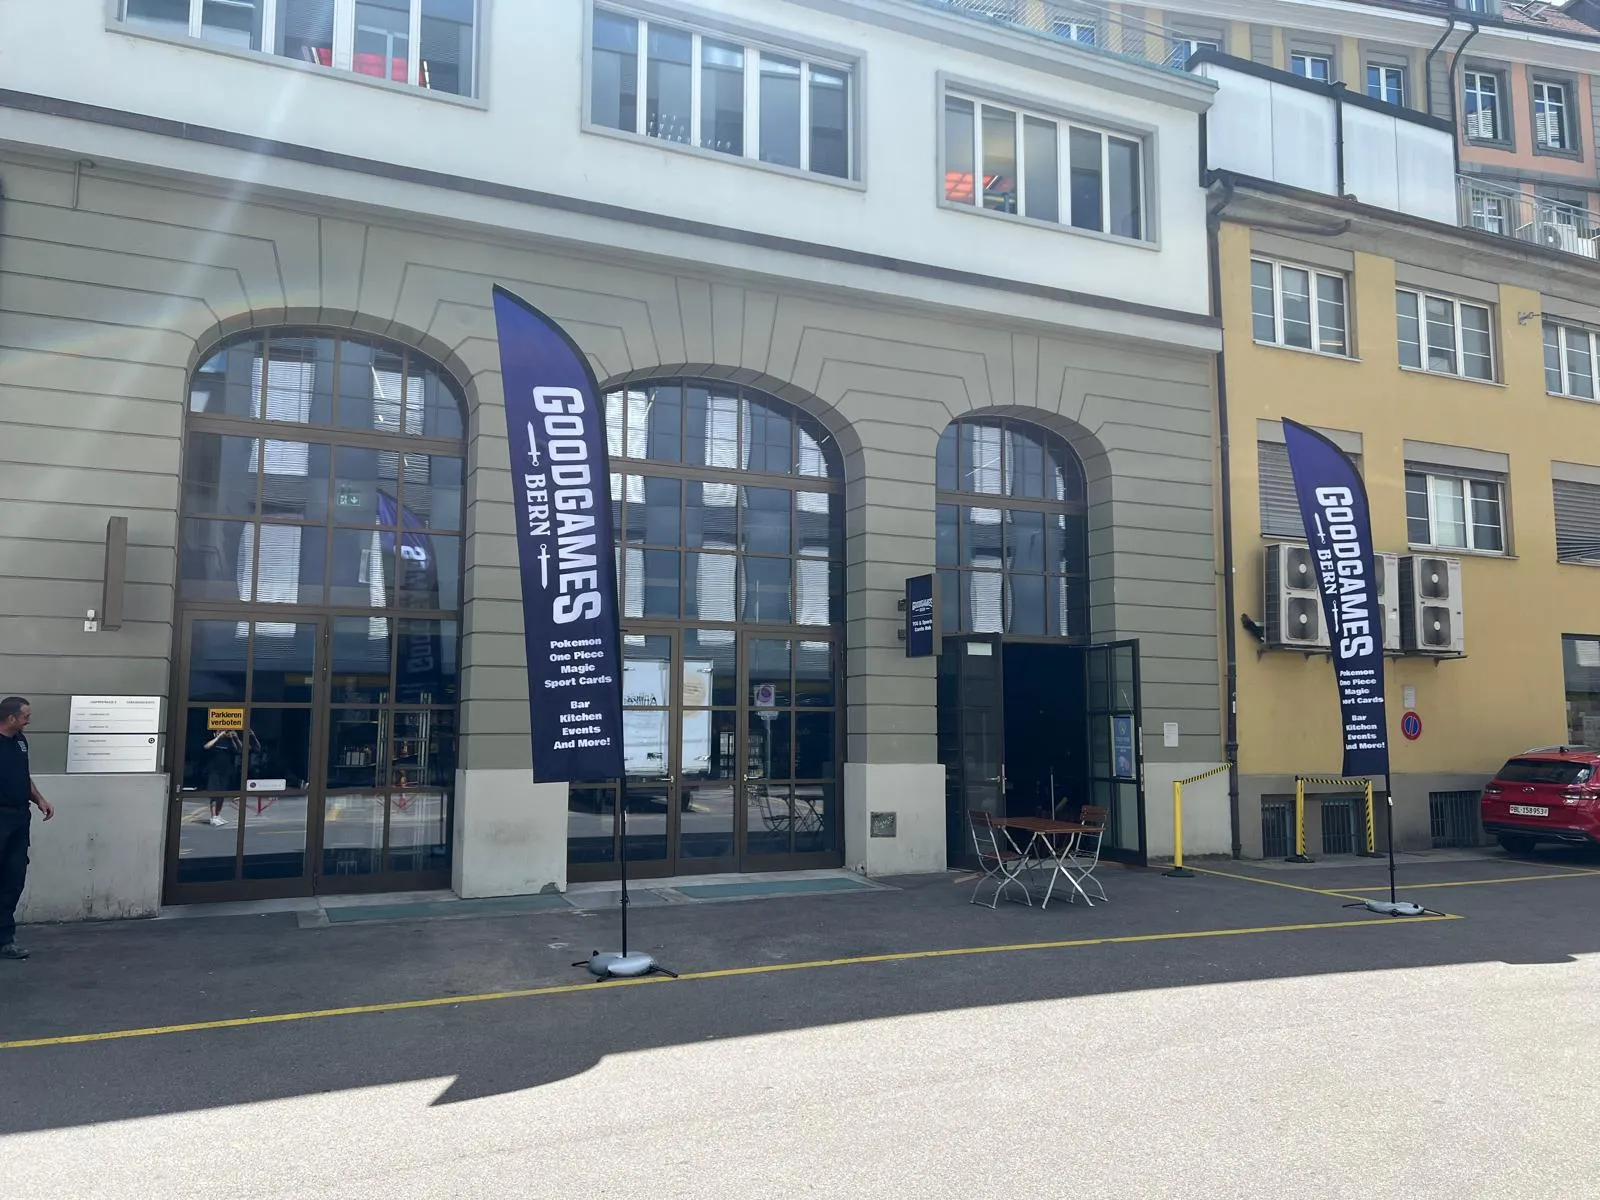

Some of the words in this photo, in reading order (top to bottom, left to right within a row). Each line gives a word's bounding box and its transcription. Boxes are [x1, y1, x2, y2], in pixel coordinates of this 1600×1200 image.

[524, 472, 551, 537] BERN
[532, 385, 602, 625] GOODGAMES
[1315, 486, 1374, 659] GOODGAMES
[1316, 548, 1338, 595] BERN
[550, 638, 602, 649] Pokemon
[549, 653, 571, 662] One
[573, 650, 604, 660] Piece
[560, 663, 596, 674] Magic
[544, 677, 576, 688] Sport
[579, 675, 613, 685] Cards
[570, 700, 591, 710] Bar
[1356, 696, 1384, 704] Cards
[559, 712, 602, 723] Kitchen
[562, 725, 601, 736] Events
[553, 740, 575, 750] And
[577, 737, 611, 748] More!
